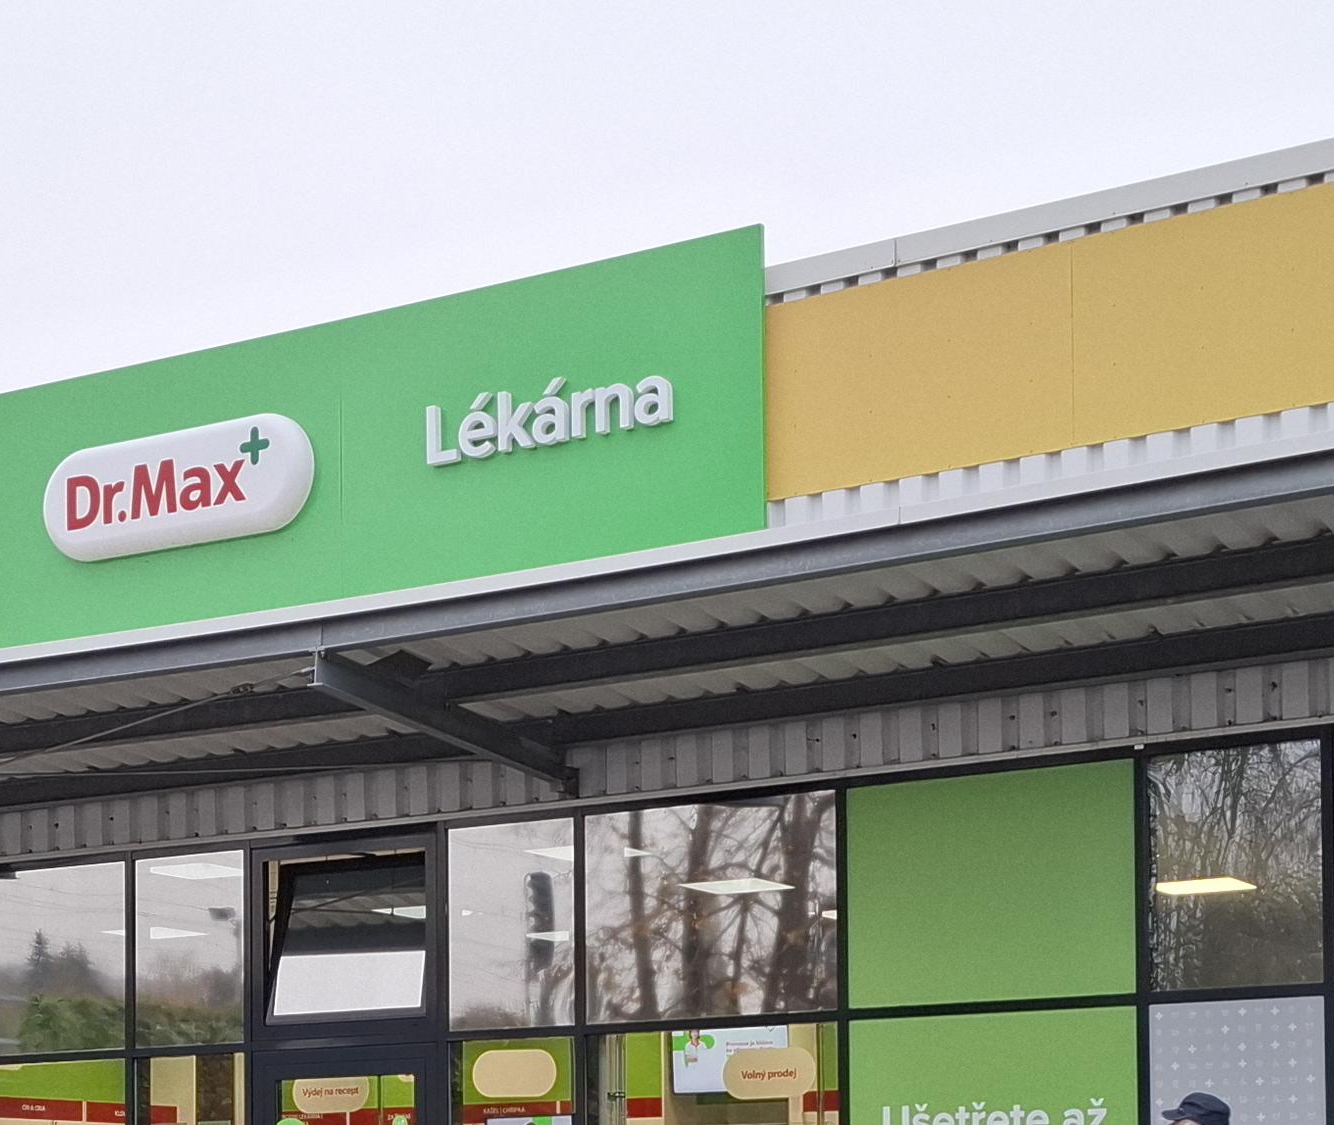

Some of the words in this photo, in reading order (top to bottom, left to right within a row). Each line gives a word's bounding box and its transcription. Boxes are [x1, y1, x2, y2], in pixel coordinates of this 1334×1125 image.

[426, 375, 674, 467] Lékárna
[741, 1069, 766, 1081] Volný
[767, 1068, 797, 1081] prodej
[302, 1087, 323, 1098] Výdej
[334, 1087, 359, 1096] recept
